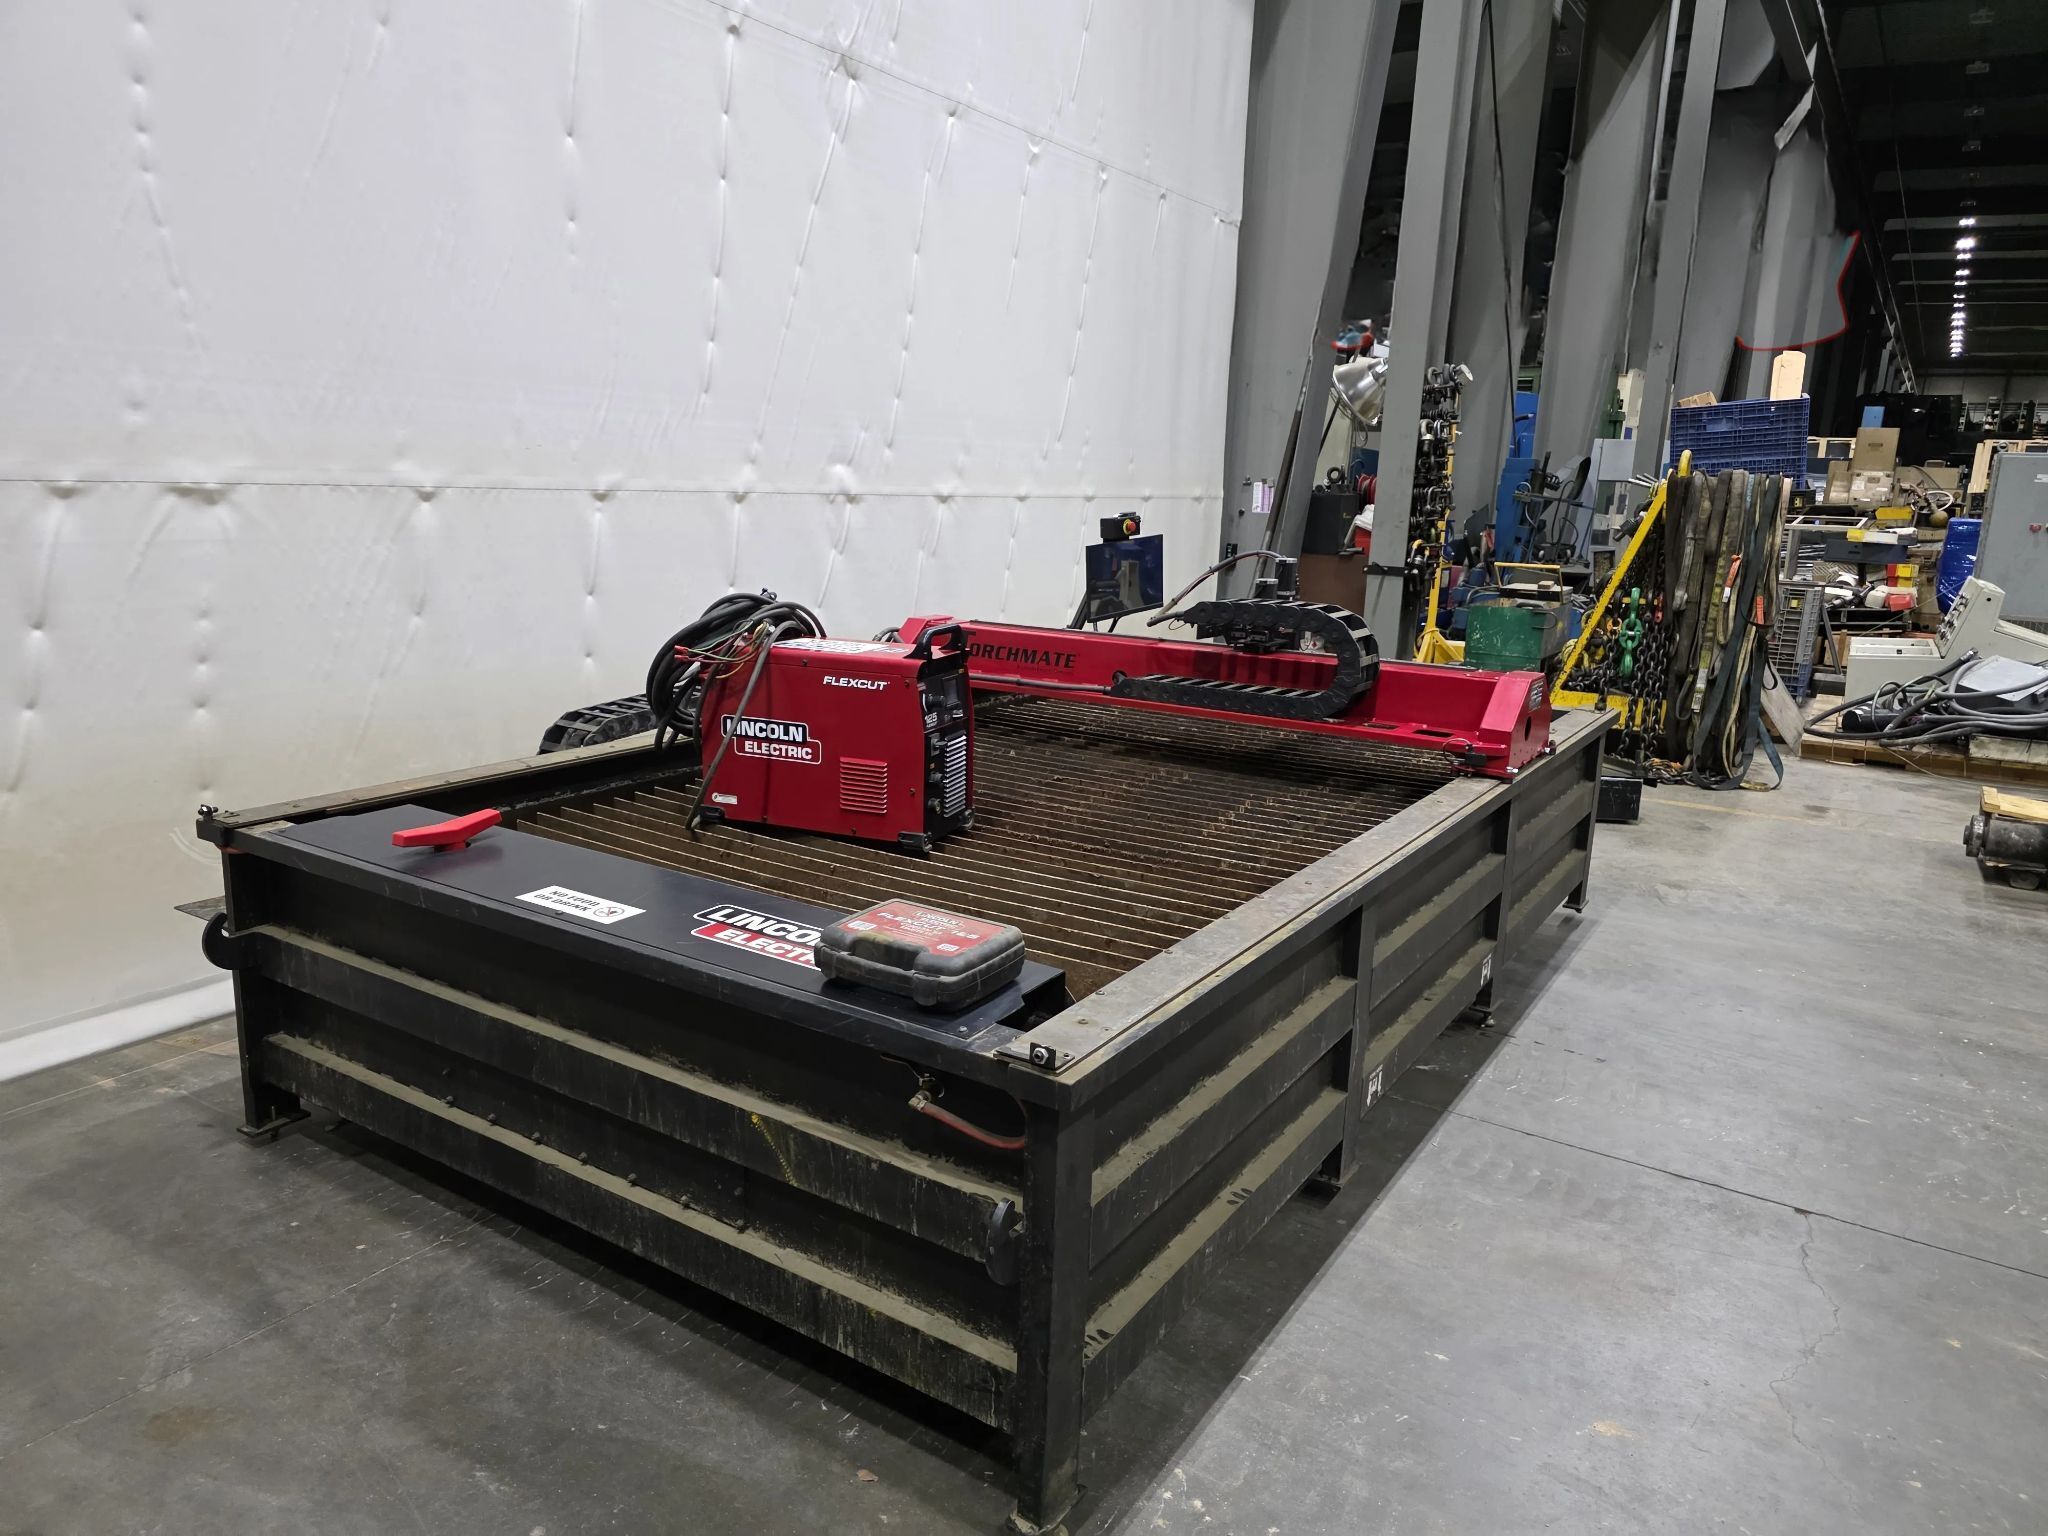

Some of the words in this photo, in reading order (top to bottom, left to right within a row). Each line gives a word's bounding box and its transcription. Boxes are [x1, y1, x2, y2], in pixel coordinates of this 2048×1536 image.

[823, 675, 887, 691] FLEXCUT
[924, 711, 938, 724] 125
[744, 740, 812, 760] ELECTRIC
